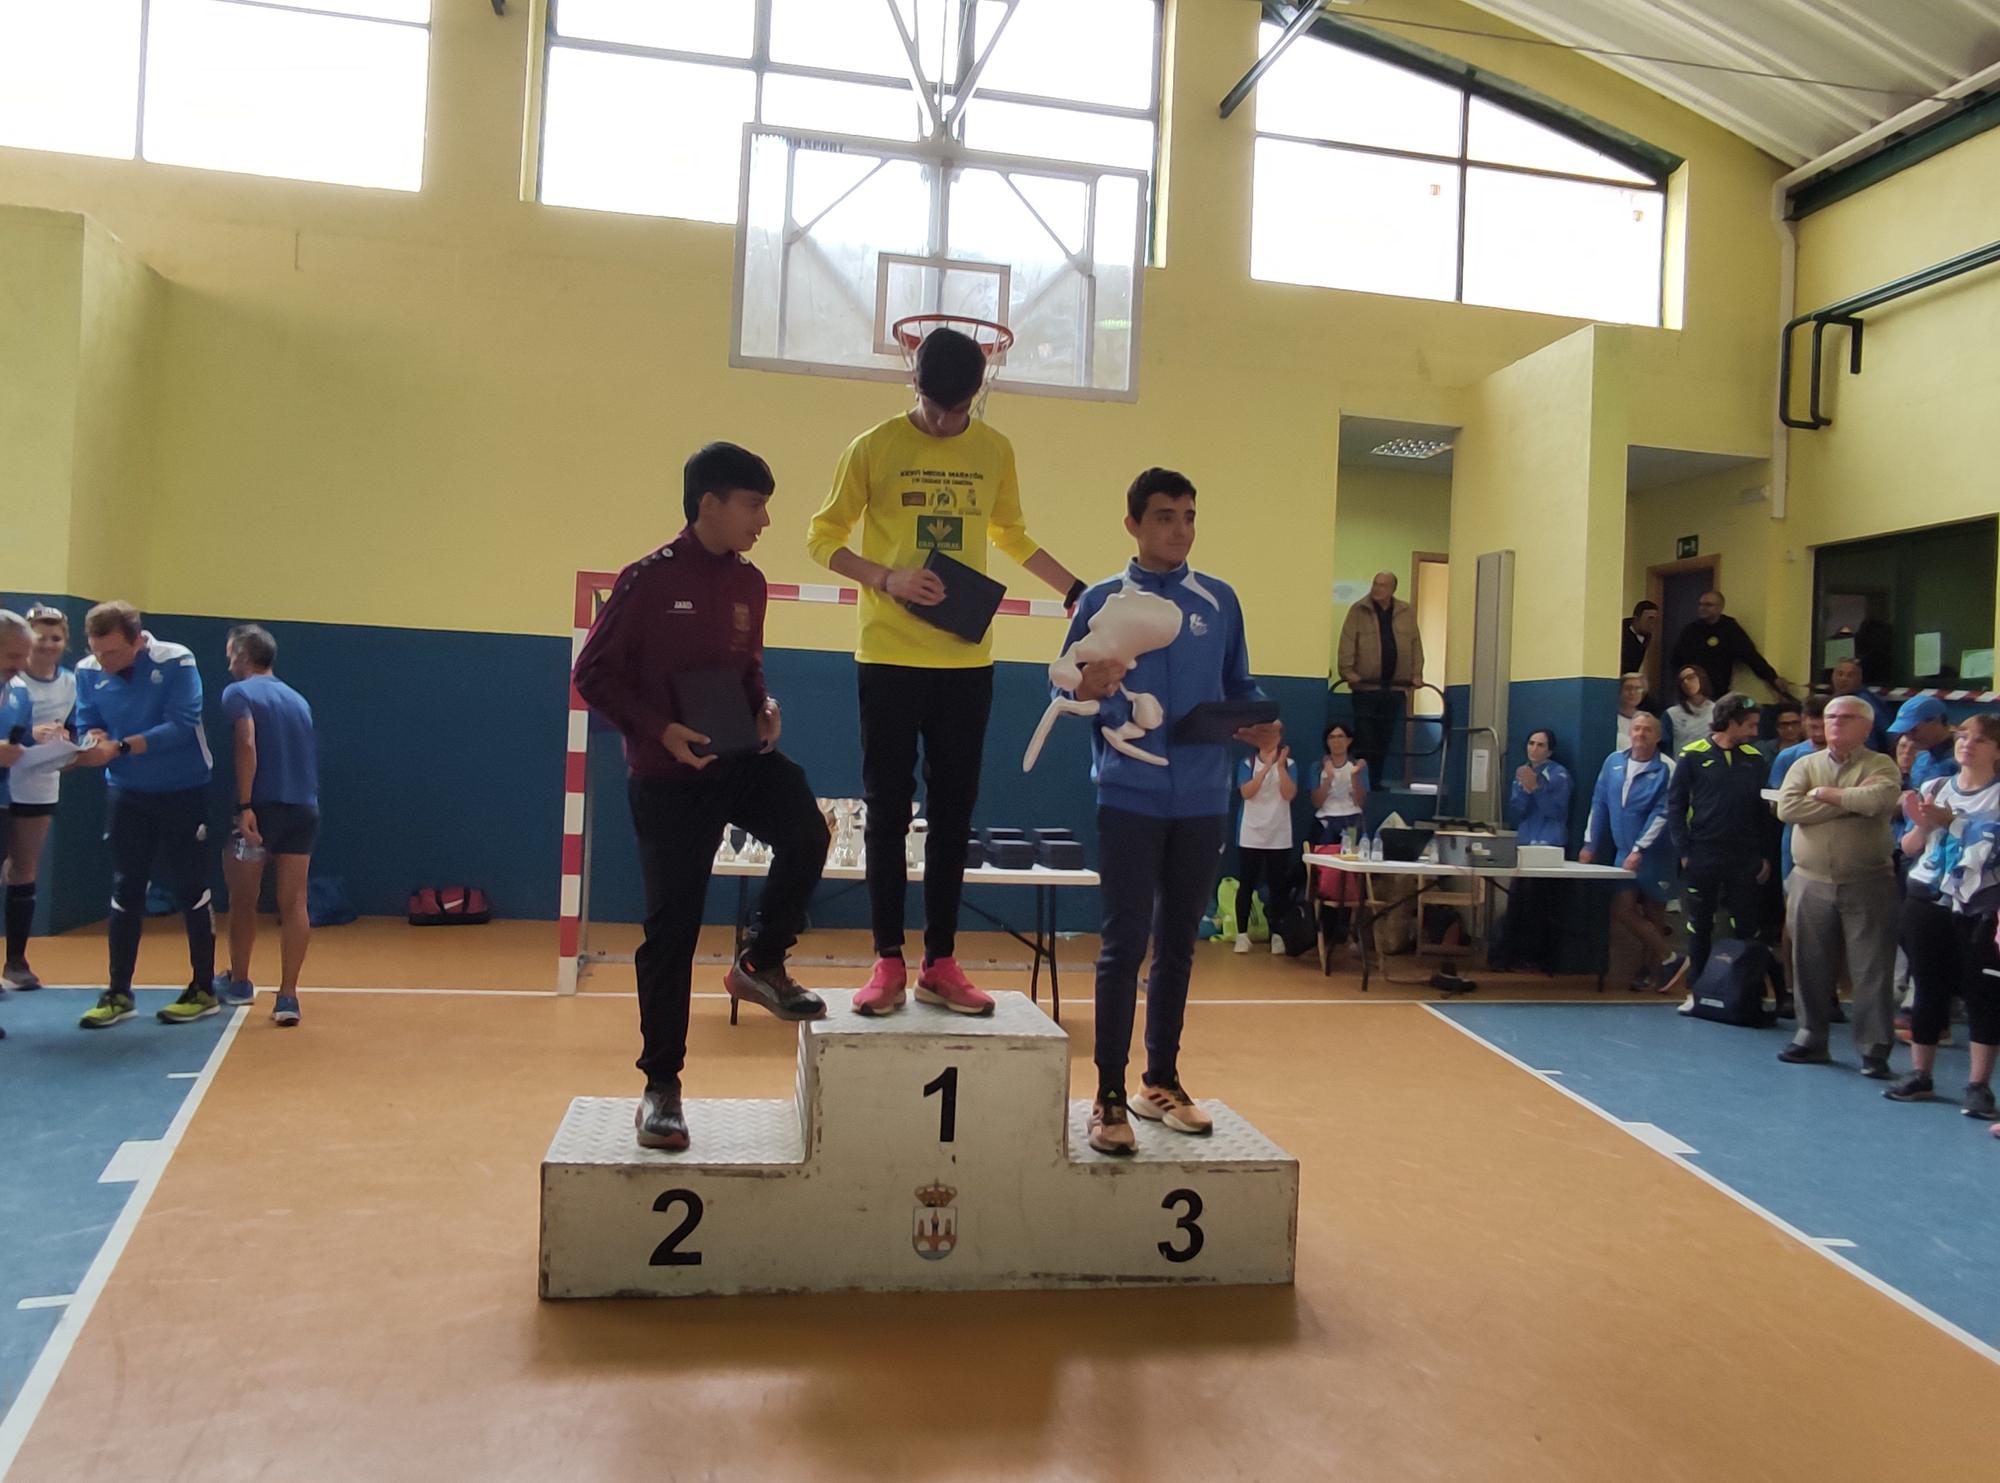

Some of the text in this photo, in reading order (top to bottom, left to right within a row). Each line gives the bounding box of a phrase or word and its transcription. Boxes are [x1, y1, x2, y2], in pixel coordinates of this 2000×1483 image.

[924, 1067, 957, 1142] 1
[648, 1188, 704, 1266] 2
[1157, 1189, 1204, 1263] 3
